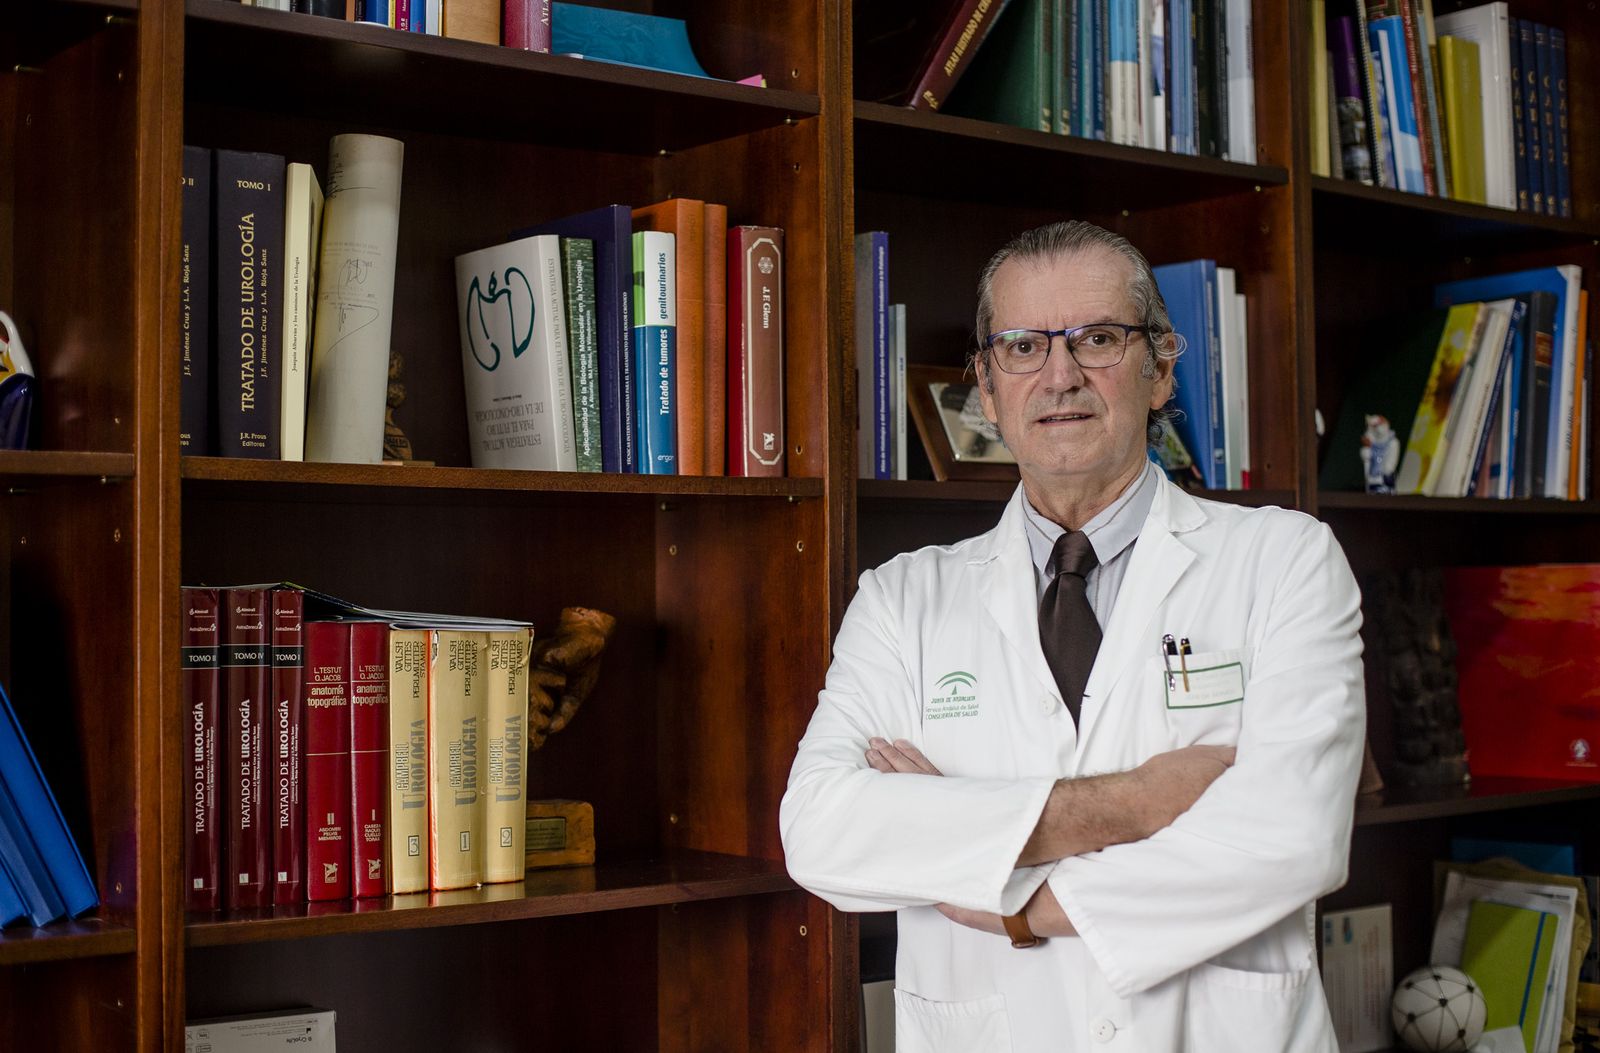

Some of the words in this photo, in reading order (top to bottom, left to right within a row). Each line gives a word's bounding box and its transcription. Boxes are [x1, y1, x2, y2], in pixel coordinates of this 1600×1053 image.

[237, 180, 264, 190] TOMO
[267, 183, 271, 192] I
[238, 212, 254, 302] UROLOGÍA
[658, 252, 668, 320] genitourinarios
[241, 306, 254, 329] DE
[578, 302, 584, 312] en
[660, 329, 668, 363] tumores
[241, 332, 254, 412] TRATADO
[660, 364, 668, 378] de
[582, 396, 588, 406] de
[660, 380, 669, 415] Tratado
[582, 408, 590, 456] Aplicabilidad
[396, 641, 404, 672] WALSH
[404, 641, 412, 672] GITTES
[491, 640, 500, 670] WALSH
[307, 695, 347, 708] topográfica
[312, 685, 343, 695] anatomía
[192, 702, 204, 762] UROLOGÍA
[239, 699, 250, 758] UROLOGÍA
[278, 700, 288, 758] UROLOGÍA
[195, 764, 204, 779] DE
[241, 761, 250, 776] DE
[280, 761, 288, 775] DE
[396, 742, 409, 790] CAMPBELL
[402, 719, 425, 811] UROLOGIA
[450, 739, 461, 787] CAMPBELL
[455, 716, 477, 807] UROLOGIA
[489, 737, 503, 784] CAMPBELL
[496, 715, 521, 802] UROLOGIA
[195, 782, 204, 834] TRATADO
[241, 778, 250, 830] TRATADO
[280, 778, 289, 828] TRATADO
[327, 812, 334, 825] II
[372, 809, 375, 821] I
[410, 838, 418, 854] 3
[462, 834, 468, 848] 1
[502, 830, 510, 844] 2
